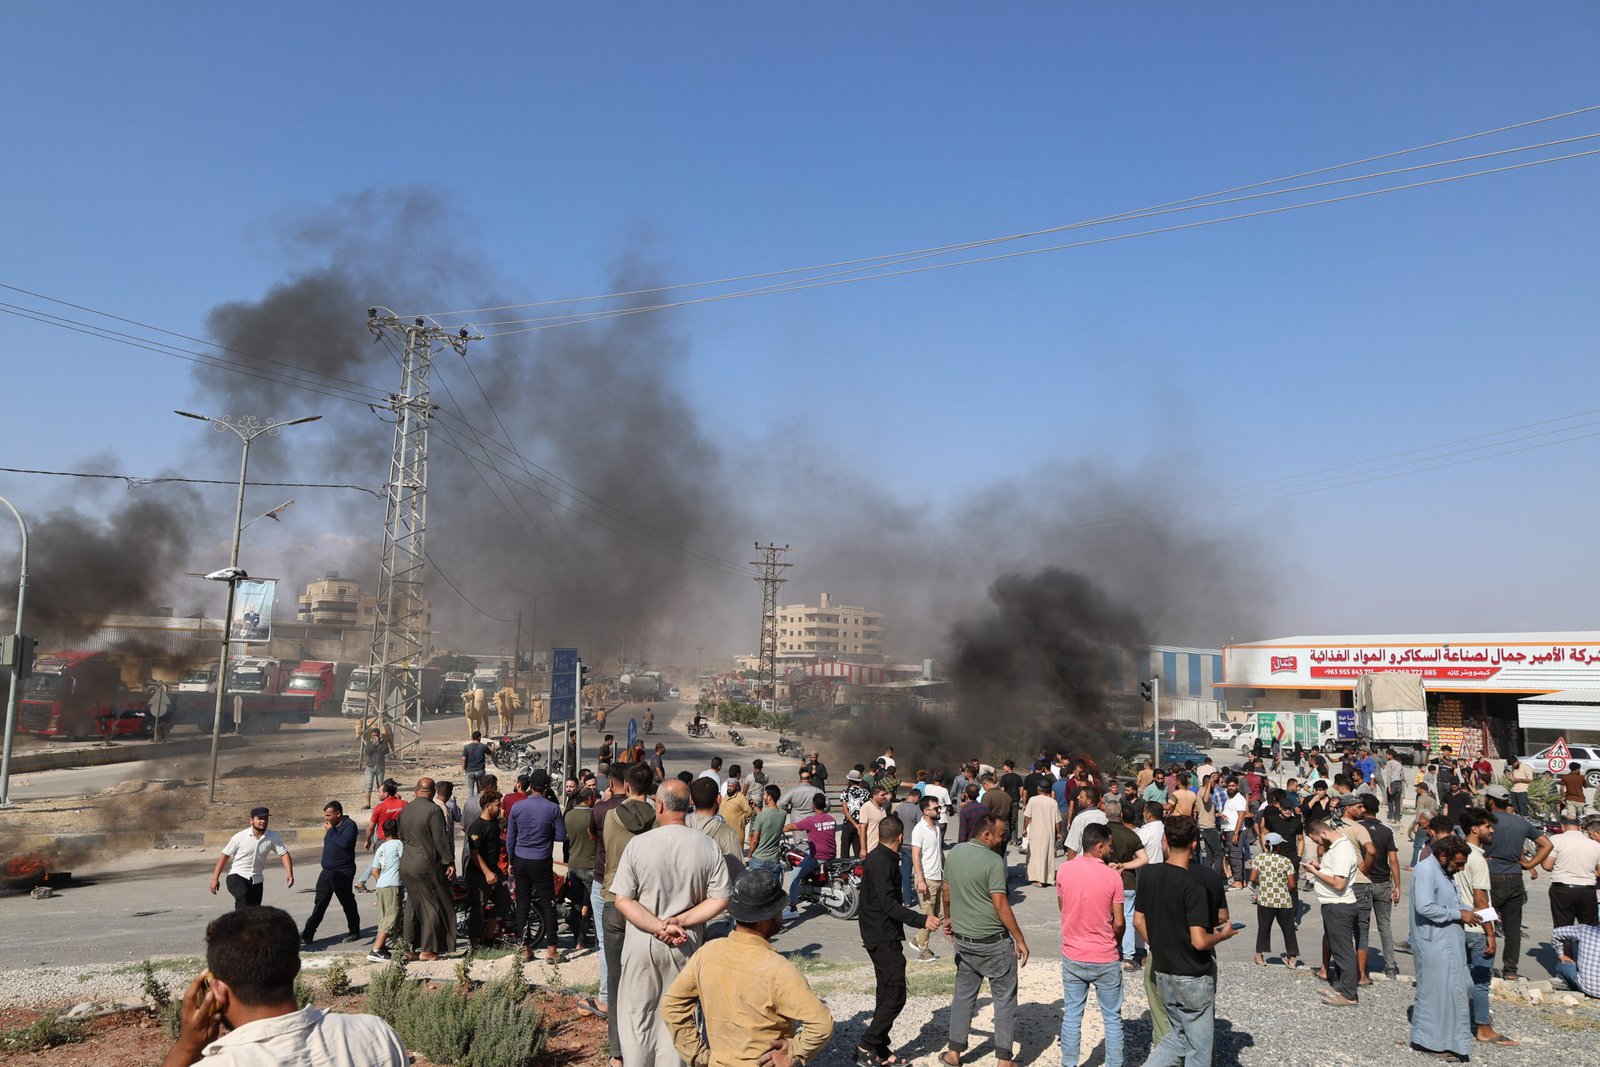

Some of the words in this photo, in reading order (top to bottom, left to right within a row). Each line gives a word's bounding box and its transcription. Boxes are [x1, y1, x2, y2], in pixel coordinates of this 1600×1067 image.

[1310, 649, 1350, 665] الغذائية
[1353, 649, 1386, 665] المواد
[1443, 648, 1489, 662] لصناعة
[1491, 648, 1527, 665] جمال
[1529, 646, 1565, 665] الأمير
[1552, 760, 1563, 768] 30
